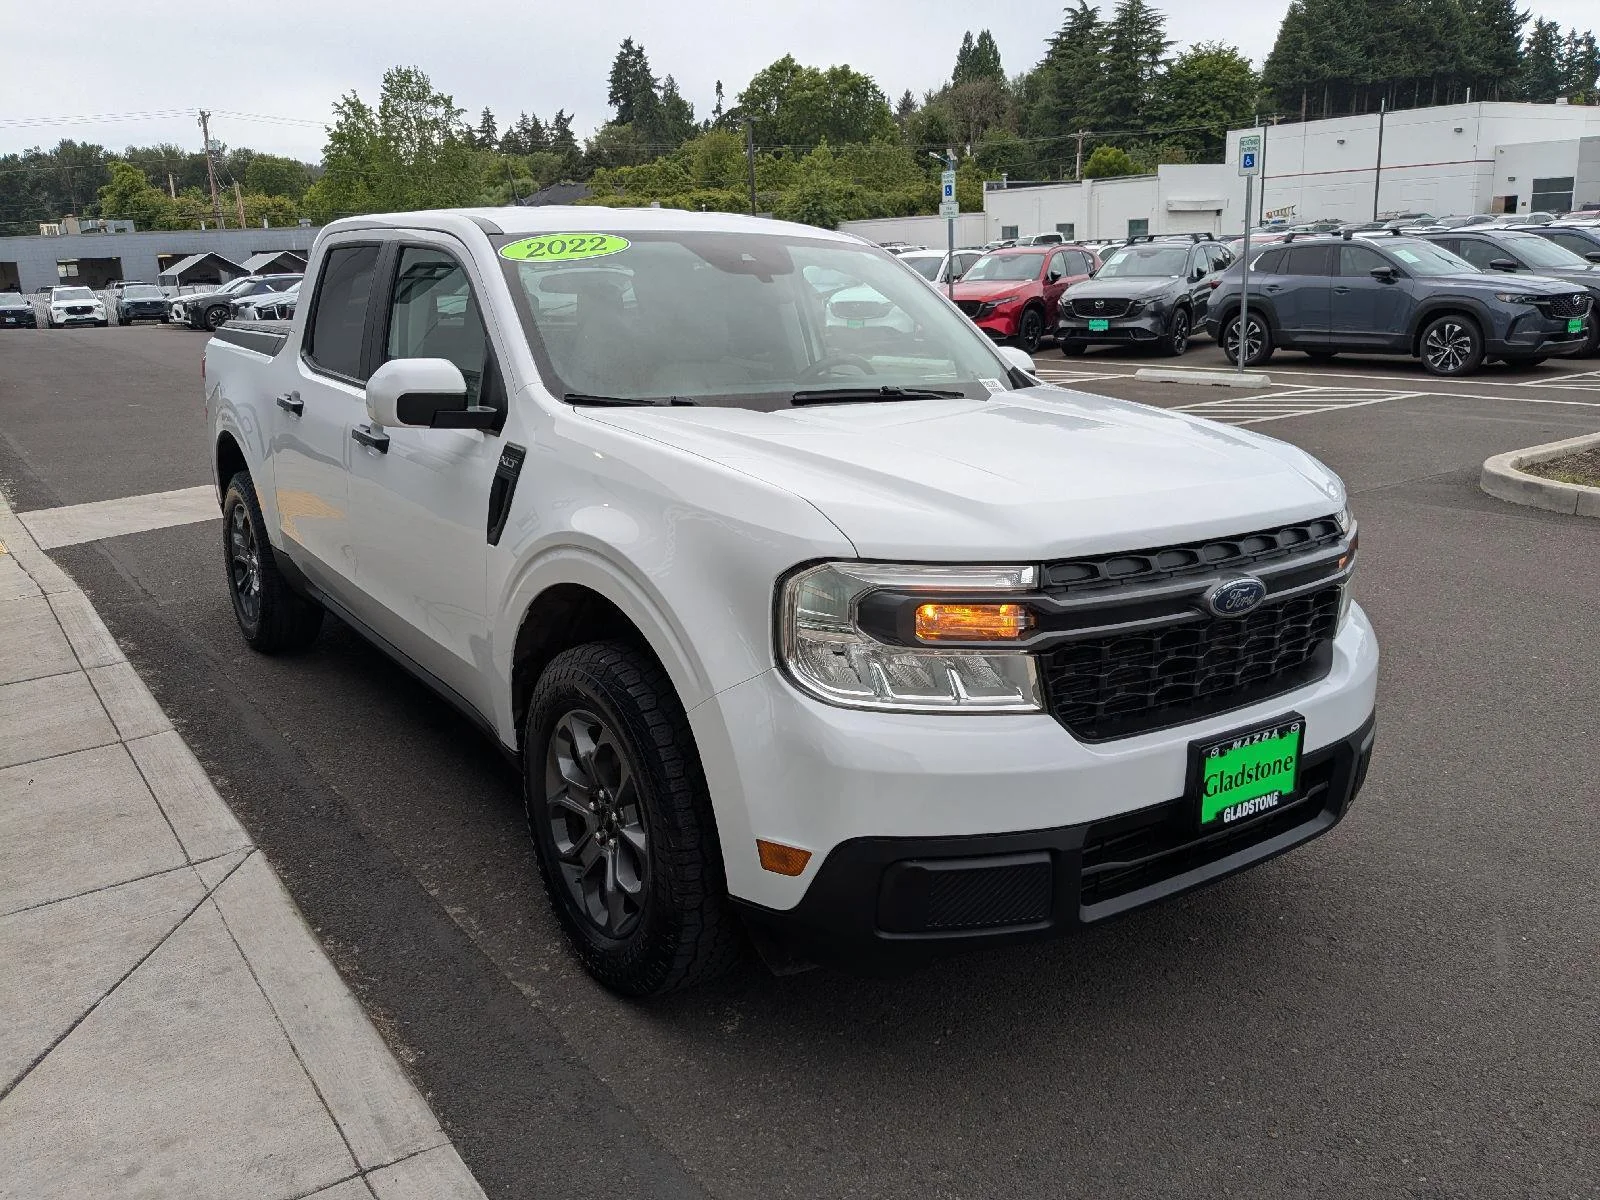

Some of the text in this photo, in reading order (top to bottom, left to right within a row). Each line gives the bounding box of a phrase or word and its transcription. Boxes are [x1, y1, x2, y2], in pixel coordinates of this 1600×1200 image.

[525, 236, 607, 258] 2022
[1226, 586, 1257, 610] Ford
[1232, 729, 1279, 750] MAZDA
[1203, 755, 1294, 798] Gladstone
[1223, 791, 1279, 823] GLADSTONE
